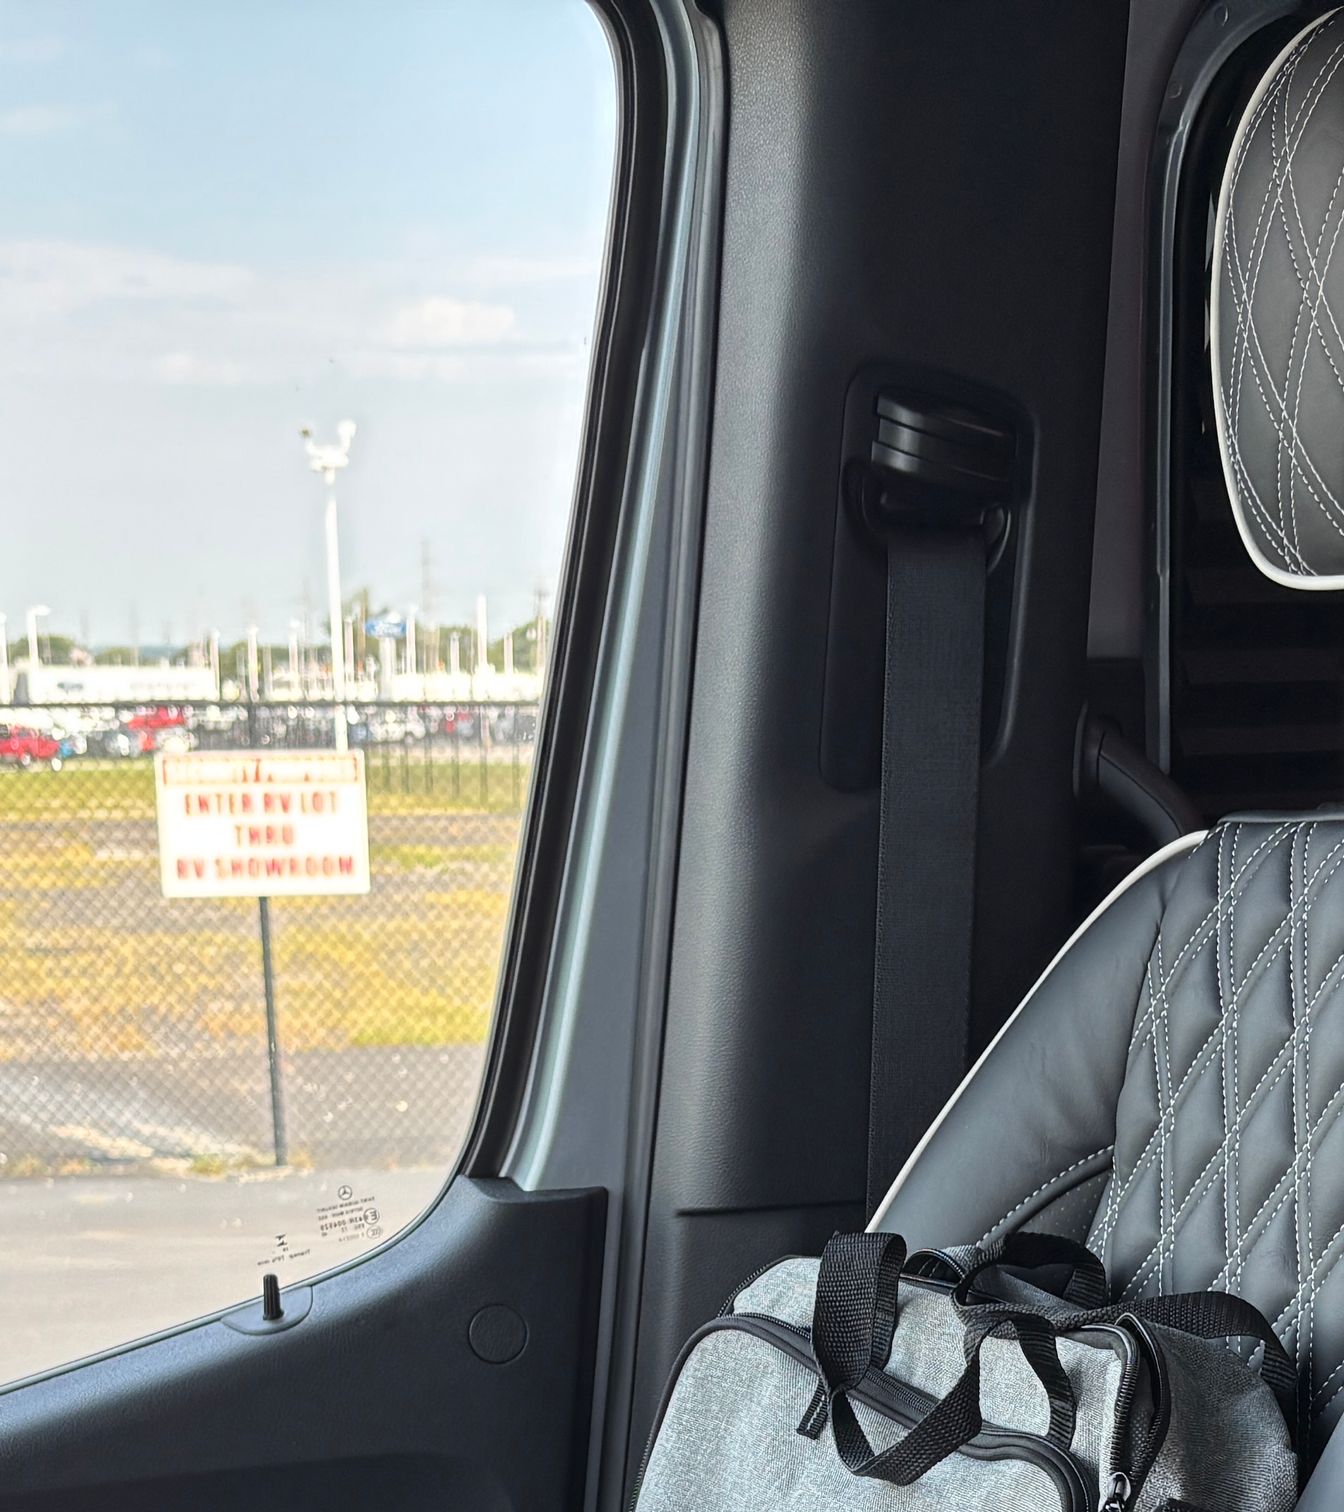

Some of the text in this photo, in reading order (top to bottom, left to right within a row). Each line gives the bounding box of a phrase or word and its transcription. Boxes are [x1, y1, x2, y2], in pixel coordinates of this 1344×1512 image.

[185, 791, 338, 816] ENTER RV LOT
[235, 825, 295, 847] THRU
[177, 856, 354, 880] RV SHOWROOM
